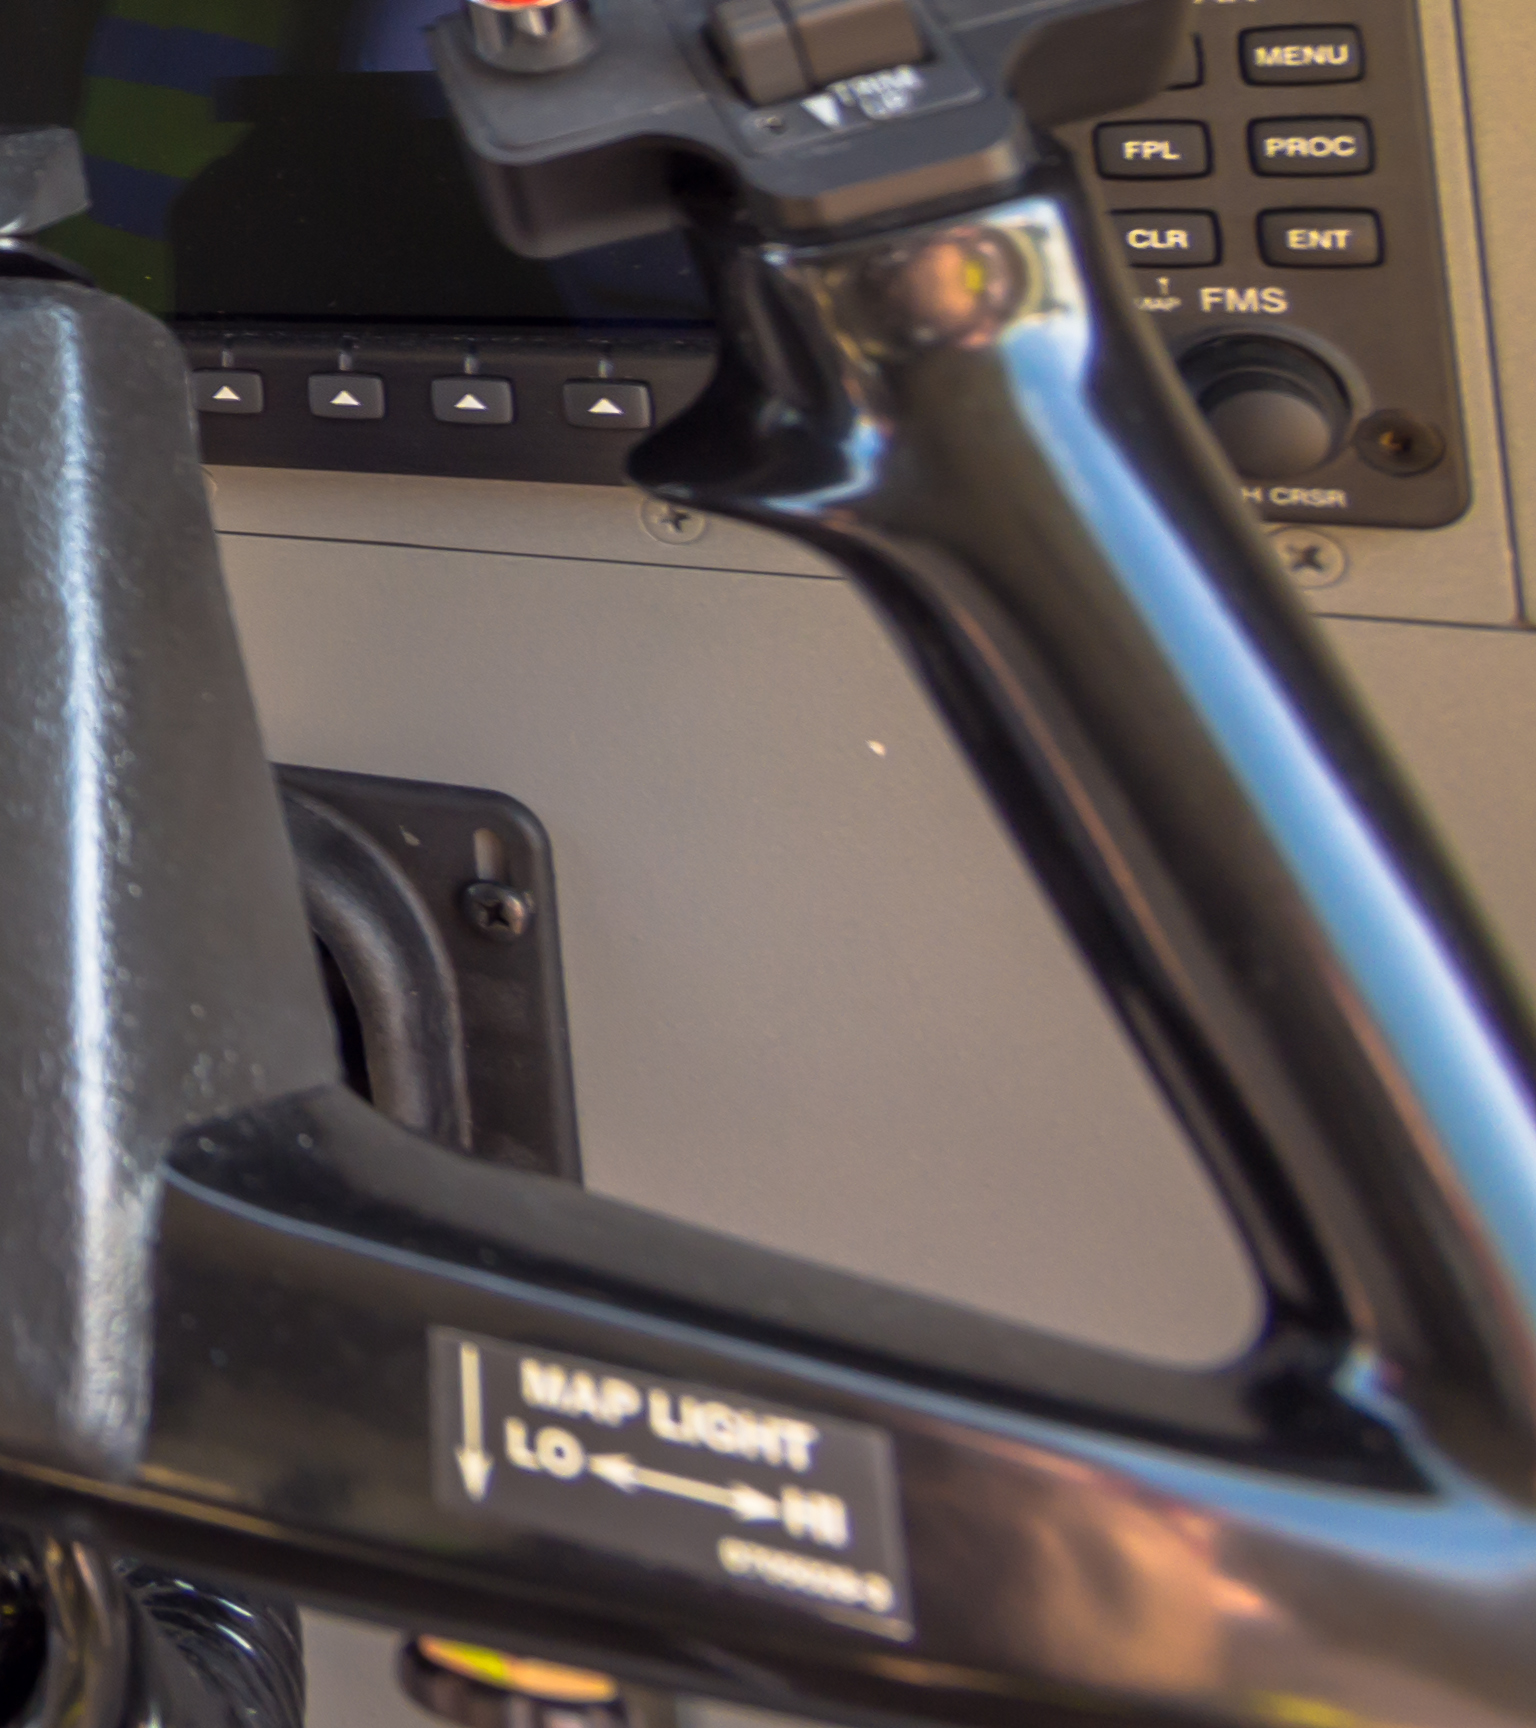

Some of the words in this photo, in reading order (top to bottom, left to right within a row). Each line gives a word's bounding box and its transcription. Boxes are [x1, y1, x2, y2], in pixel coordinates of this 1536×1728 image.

[1254, 43, 1350, 68] MENU
[1123, 139, 1181, 162] FPL
[1264, 135, 1358, 159] PROC
[1125, 228, 1190, 251] CLR
[1286, 228, 1352, 251] ENT
[1200, 286, 1289, 313] FMS
[519, 1356, 644, 1429] MAP
[647, 1387, 822, 1475] LIGHT
[503, 1415, 587, 1481] LO
[780, 1484, 852, 1551] HI
